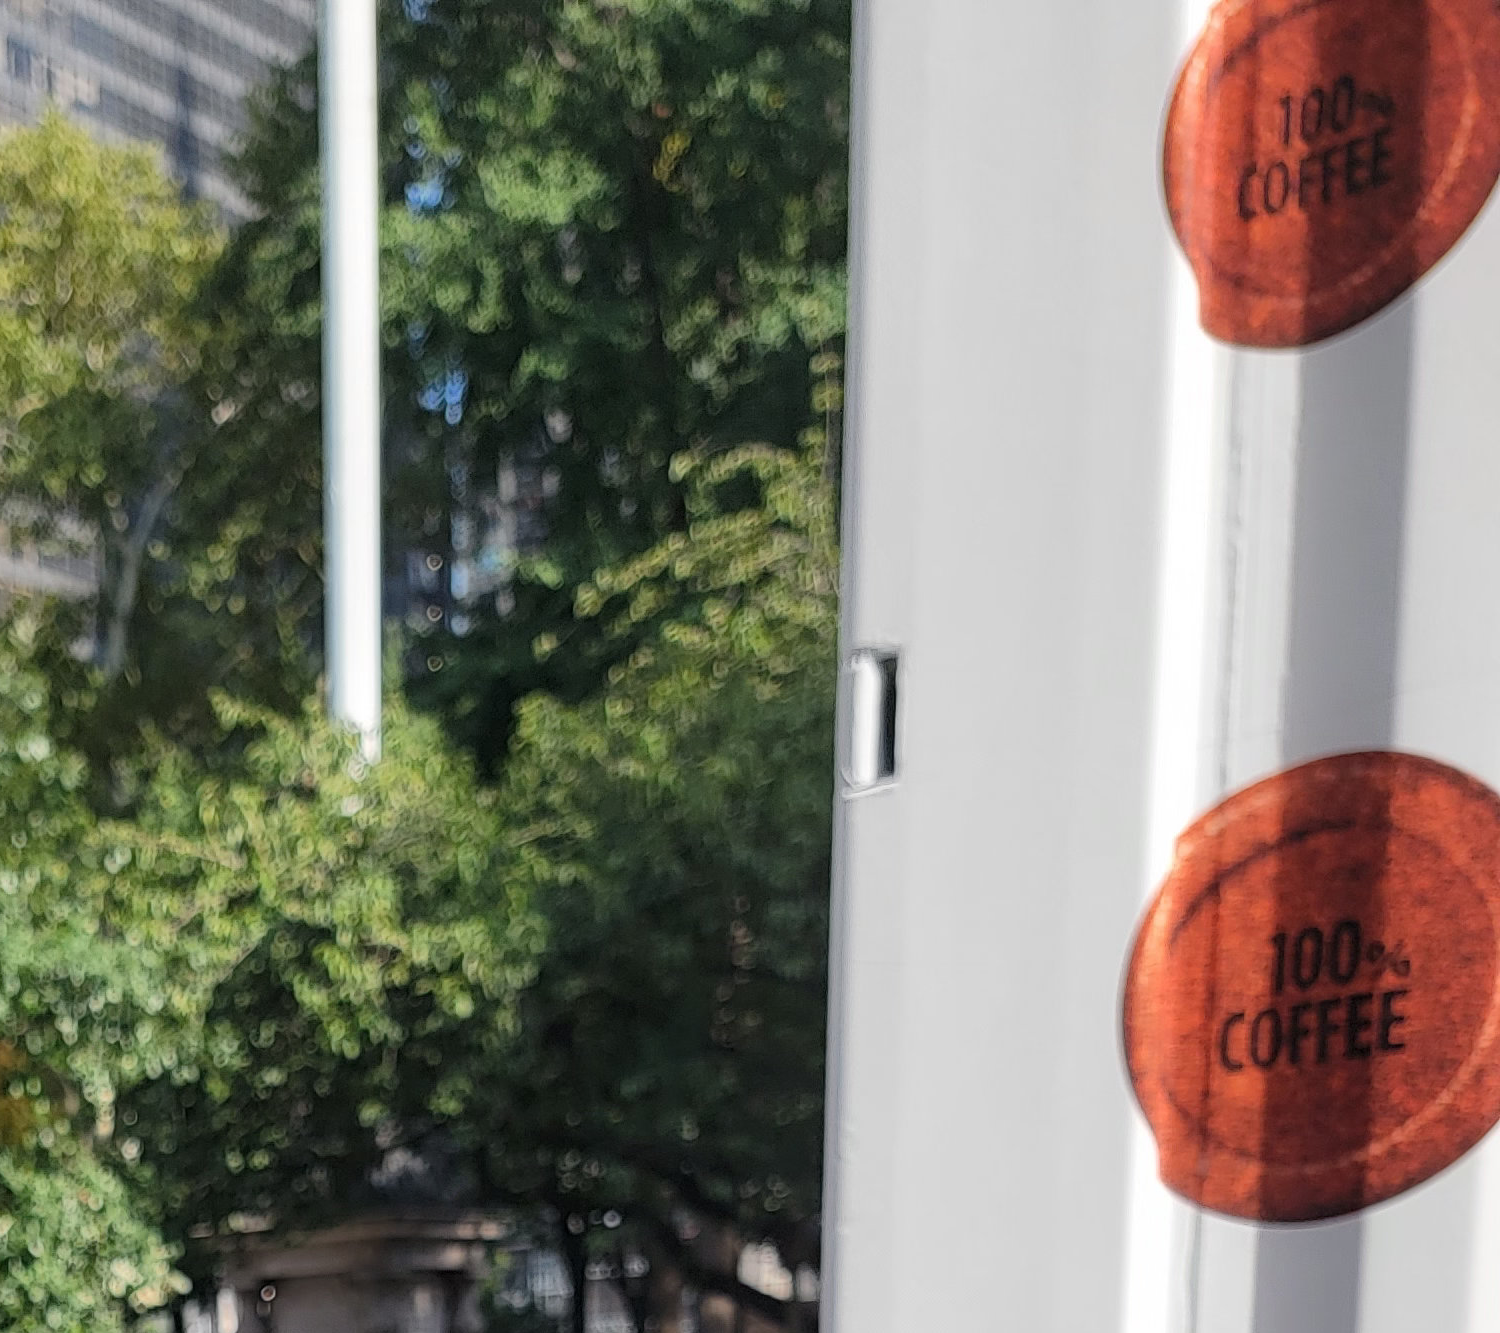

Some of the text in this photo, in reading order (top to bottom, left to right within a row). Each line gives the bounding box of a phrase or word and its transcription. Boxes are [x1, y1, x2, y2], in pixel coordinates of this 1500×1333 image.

[1238, 127, 1393, 222] COFFEE
[1271, 919, 1411, 994] 100%
[1220, 989, 1409, 1072] COFFEE
